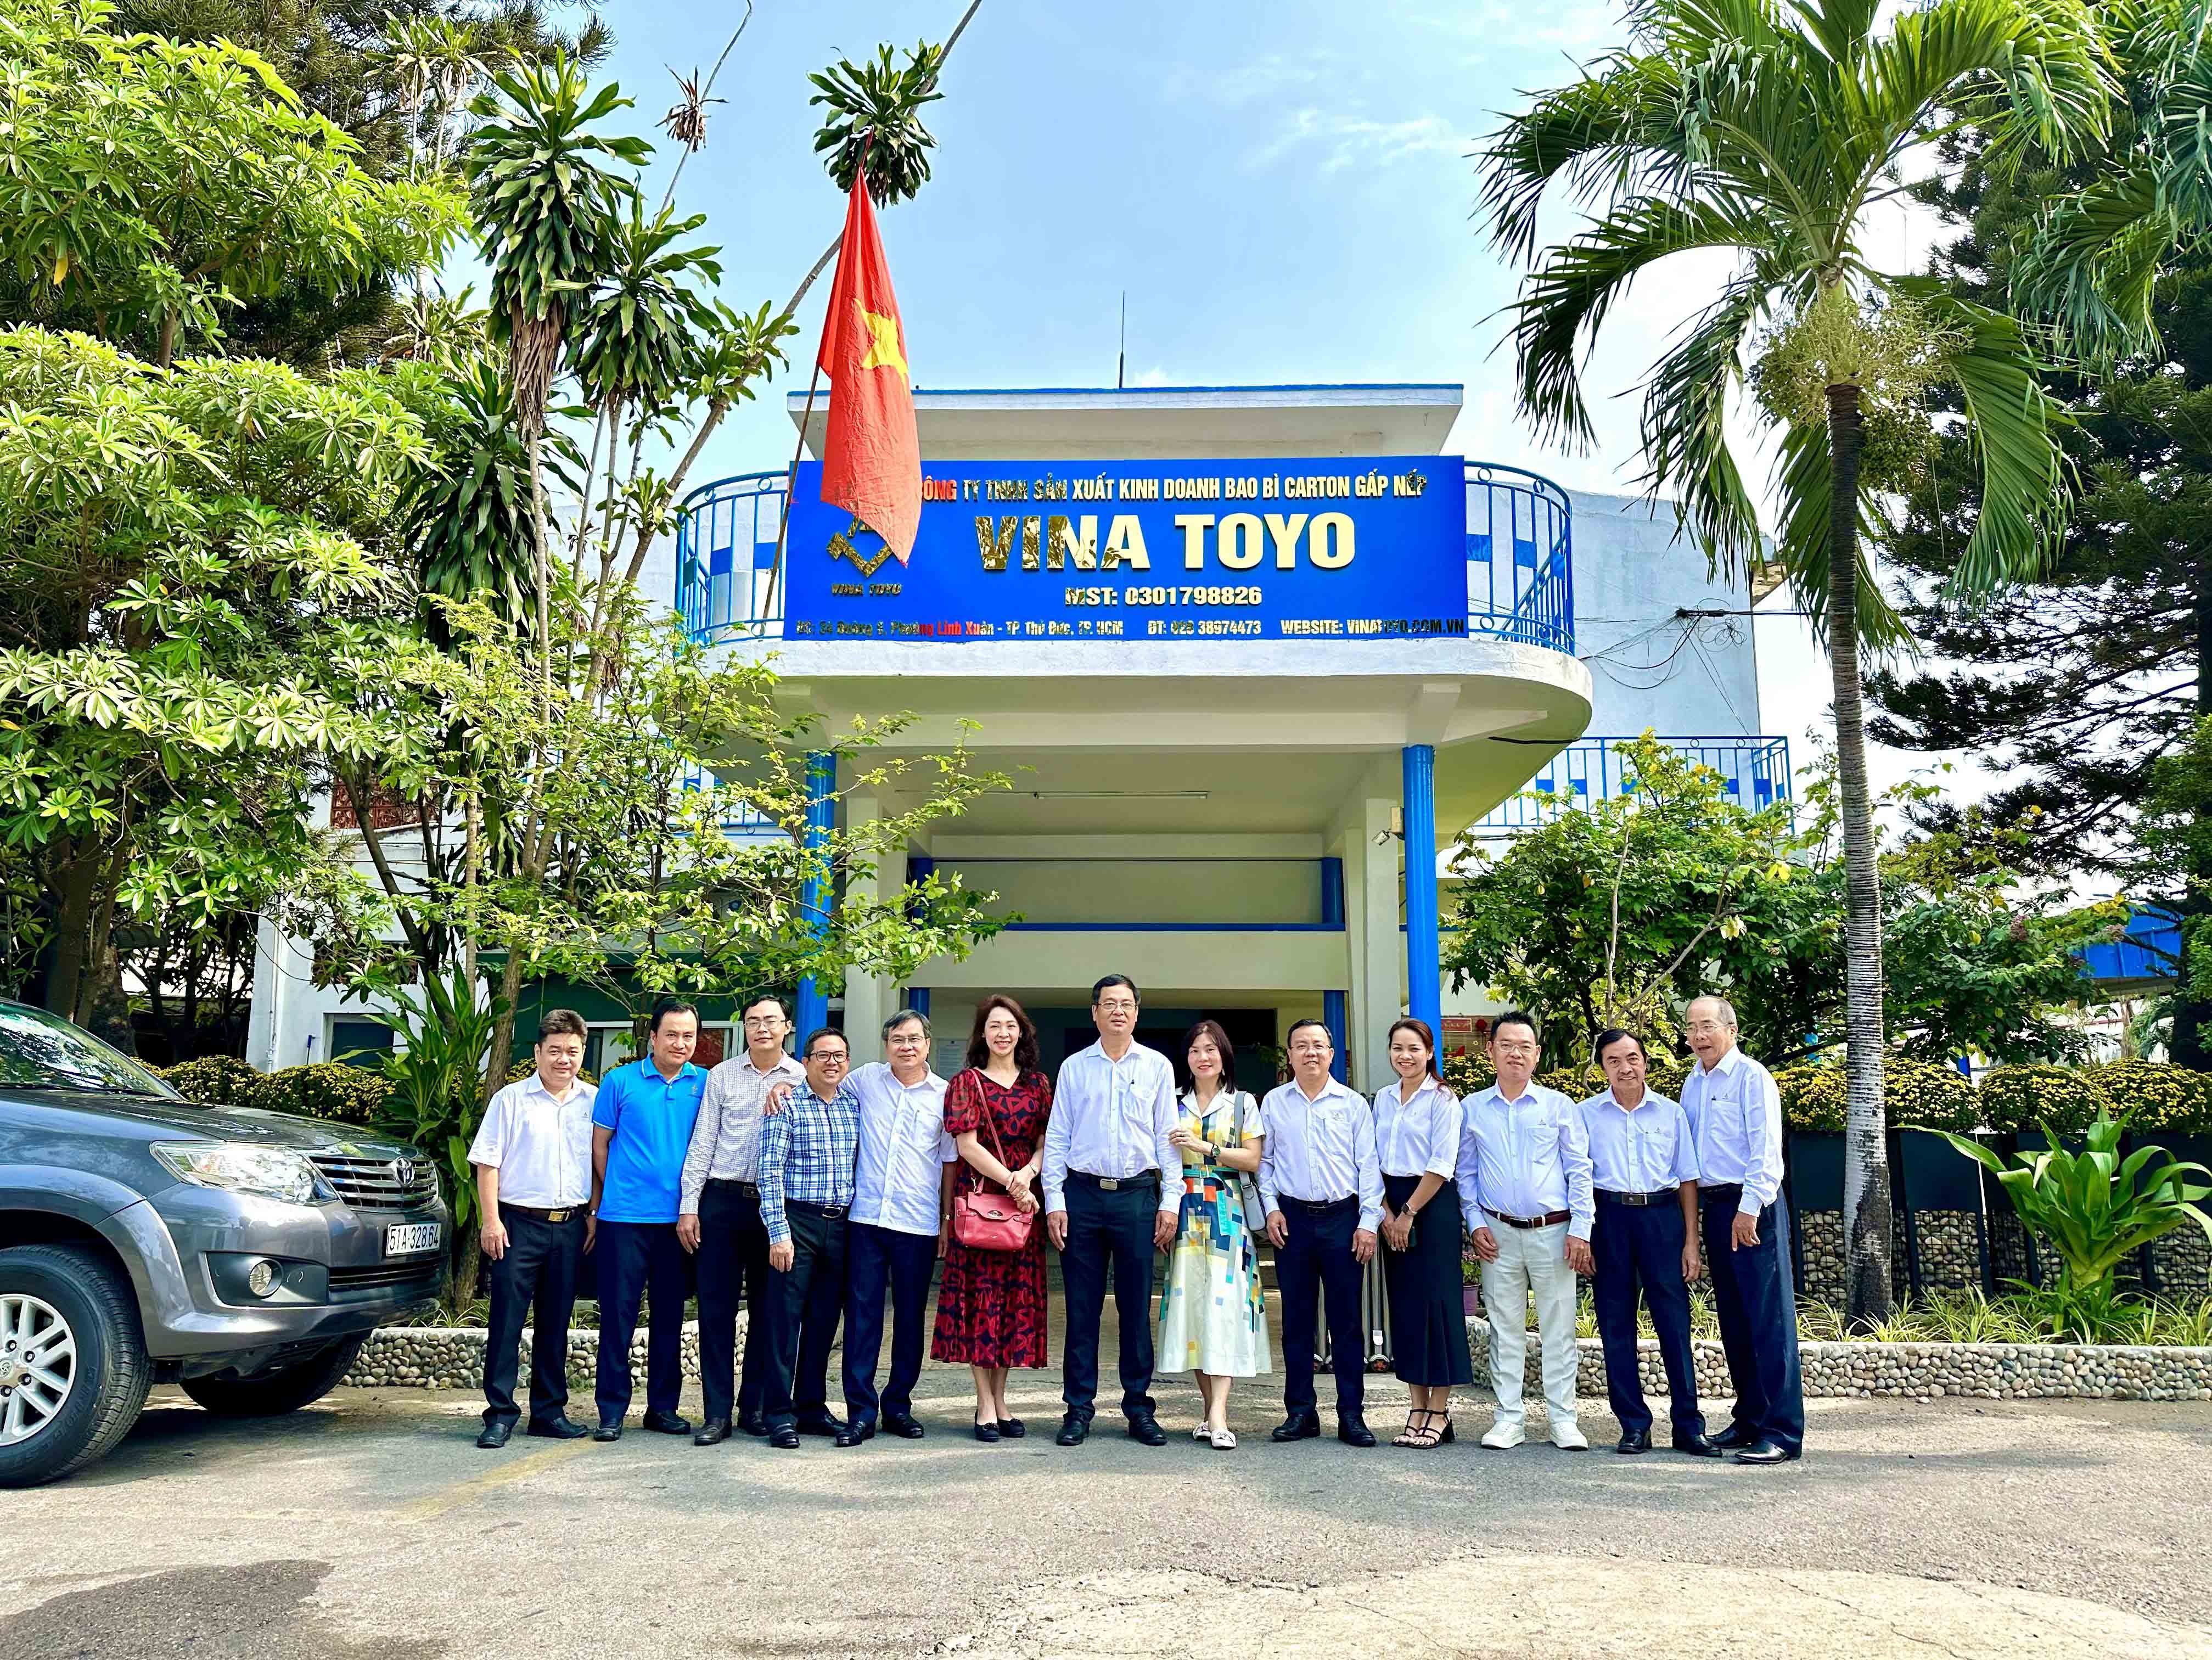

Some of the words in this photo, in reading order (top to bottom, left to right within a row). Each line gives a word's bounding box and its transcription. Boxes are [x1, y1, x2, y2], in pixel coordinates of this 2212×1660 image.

[922, 475, 957, 500] ÔNG
[963, 479, 980, 500] TY
[985, 479, 1028, 500] TNHH
[1033, 472, 1068, 500] SẢN
[1071, 472, 1115, 500] XUẤT
[1119, 479, 1158, 500] KINH
[1164, 478, 1220, 499] DOANH
[1225, 478, 1258, 498] BAO
[1263, 473, 1279, 498] BÌ
[1284, 476, 1350, 498] CARTON
[1355, 468, 1389, 497] GẤP
[974, 515, 1151, 570] VINA
[1175, 512, 1355, 569] TOYO
[1065, 587, 1118, 605] MST:
[1125, 587, 1262, 605] 0301798826
[937, 620, 962, 635] Linh
[965, 620, 994, 635] Xuân
[1025, 619, 1046, 635] Thủ
[1097, 621, 1124, 635] HCM
[1198, 620, 1262, 635] 38974473
[1281, 620, 1344, 635] WEBSITE:
